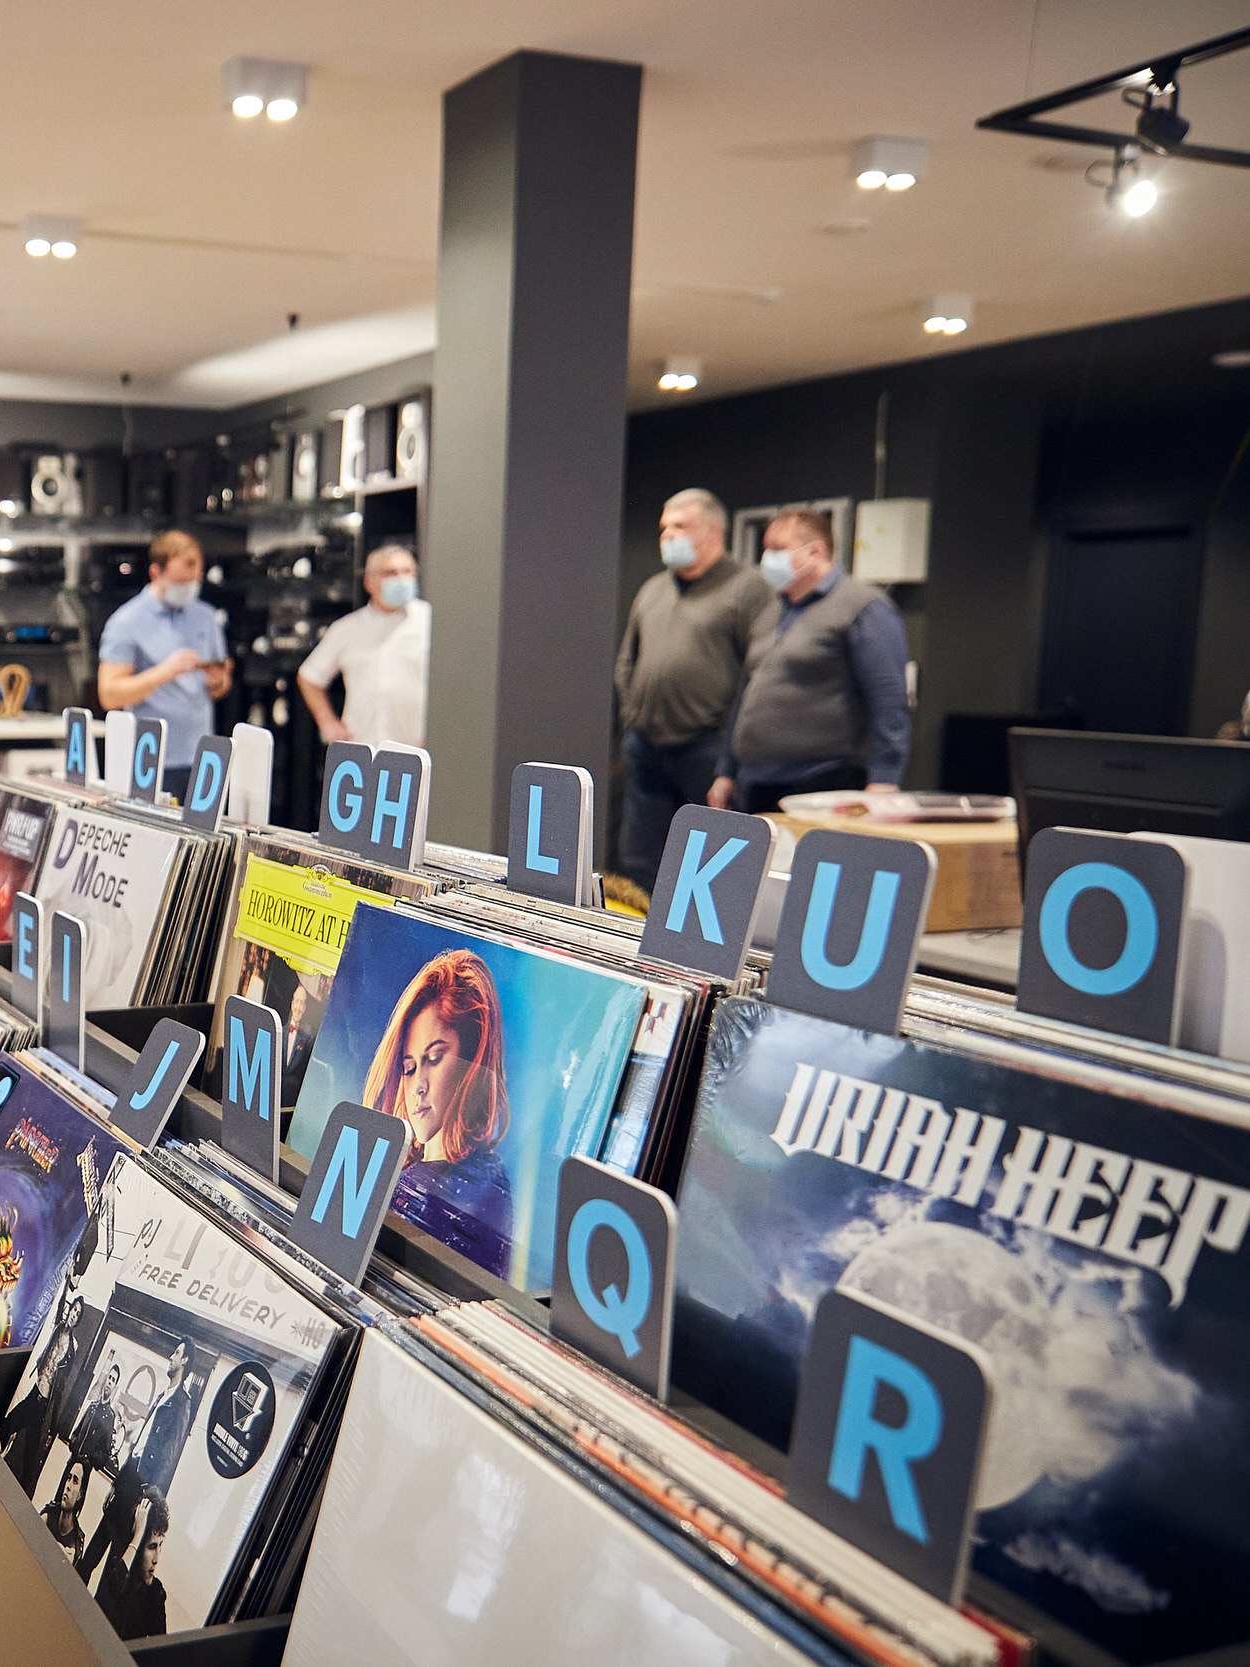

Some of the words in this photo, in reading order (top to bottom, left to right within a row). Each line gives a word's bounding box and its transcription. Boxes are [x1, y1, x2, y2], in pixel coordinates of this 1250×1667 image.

[67, 721, 85, 773] A
[134, 731, 158, 789] C
[190, 751, 223, 812] D
[329, 760, 364, 833] G
[370, 769, 412, 849] H
[526, 785, 559, 875] L
[53, 818, 132, 869] DEPECHE
[71, 852, 129, 908] MODE
[246, 889, 316, 937] HOROWITZ
[314, 912, 337, 944] AT
[665, 830, 750, 945] K
[18, 911, 35, 980] E
[800, 861, 902, 991] U
[1039, 862, 1159, 996] O
[62, 933, 71, 1002] I
[130, 1041, 180, 1111] J
[228, 1015, 275, 1121] M
[311, 1126, 391, 1240] N
[768, 1062, 1007, 1206] URIAH
[993, 1127, 1250, 1309] HEEP
[138, 1263, 182, 1289] FREE
[186, 1279, 287, 1330] DELIVERY
[567, 1198, 652, 1358] Q
[827, 1335, 943, 1544] R
